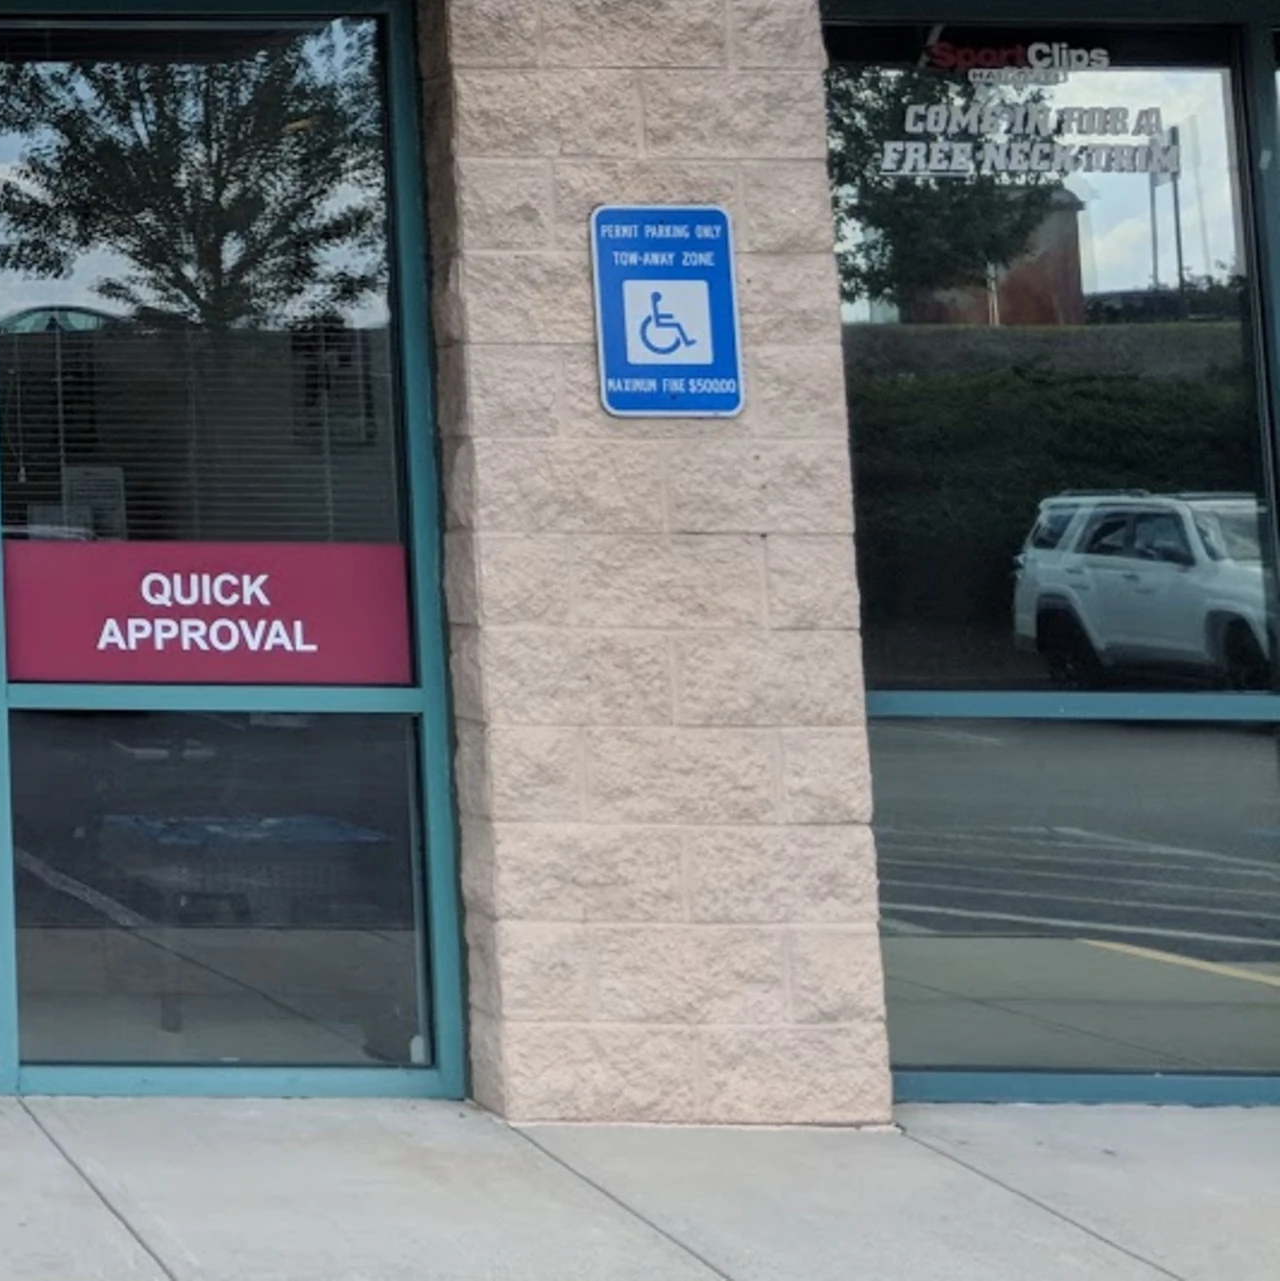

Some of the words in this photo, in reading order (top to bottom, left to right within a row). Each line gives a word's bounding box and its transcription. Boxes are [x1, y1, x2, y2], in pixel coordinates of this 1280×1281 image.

[904, 104, 1004, 135] COME
[1008, 103, 1053, 136] IN
[1060, 106, 1129, 137] FOR
[1131, 107, 1162, 136] A
[879, 140, 975, 171] FREE
[984, 141, 1077, 171] NECK
[1080, 142, 1180, 173] TRIM
[600, 224, 638, 238] PERMIT
[644, 224, 690, 239] PARKING
[695, 224, 722, 239] ONLY
[612, 251, 674, 266] TOW-AWAY
[681, 251, 715, 267] ZONE
[607, 377, 657, 393] MAXIMUM
[661, 378, 685, 393] FINE
[140, 572, 271, 607] QUICK
[96, 617, 319, 652] APPROVAL
